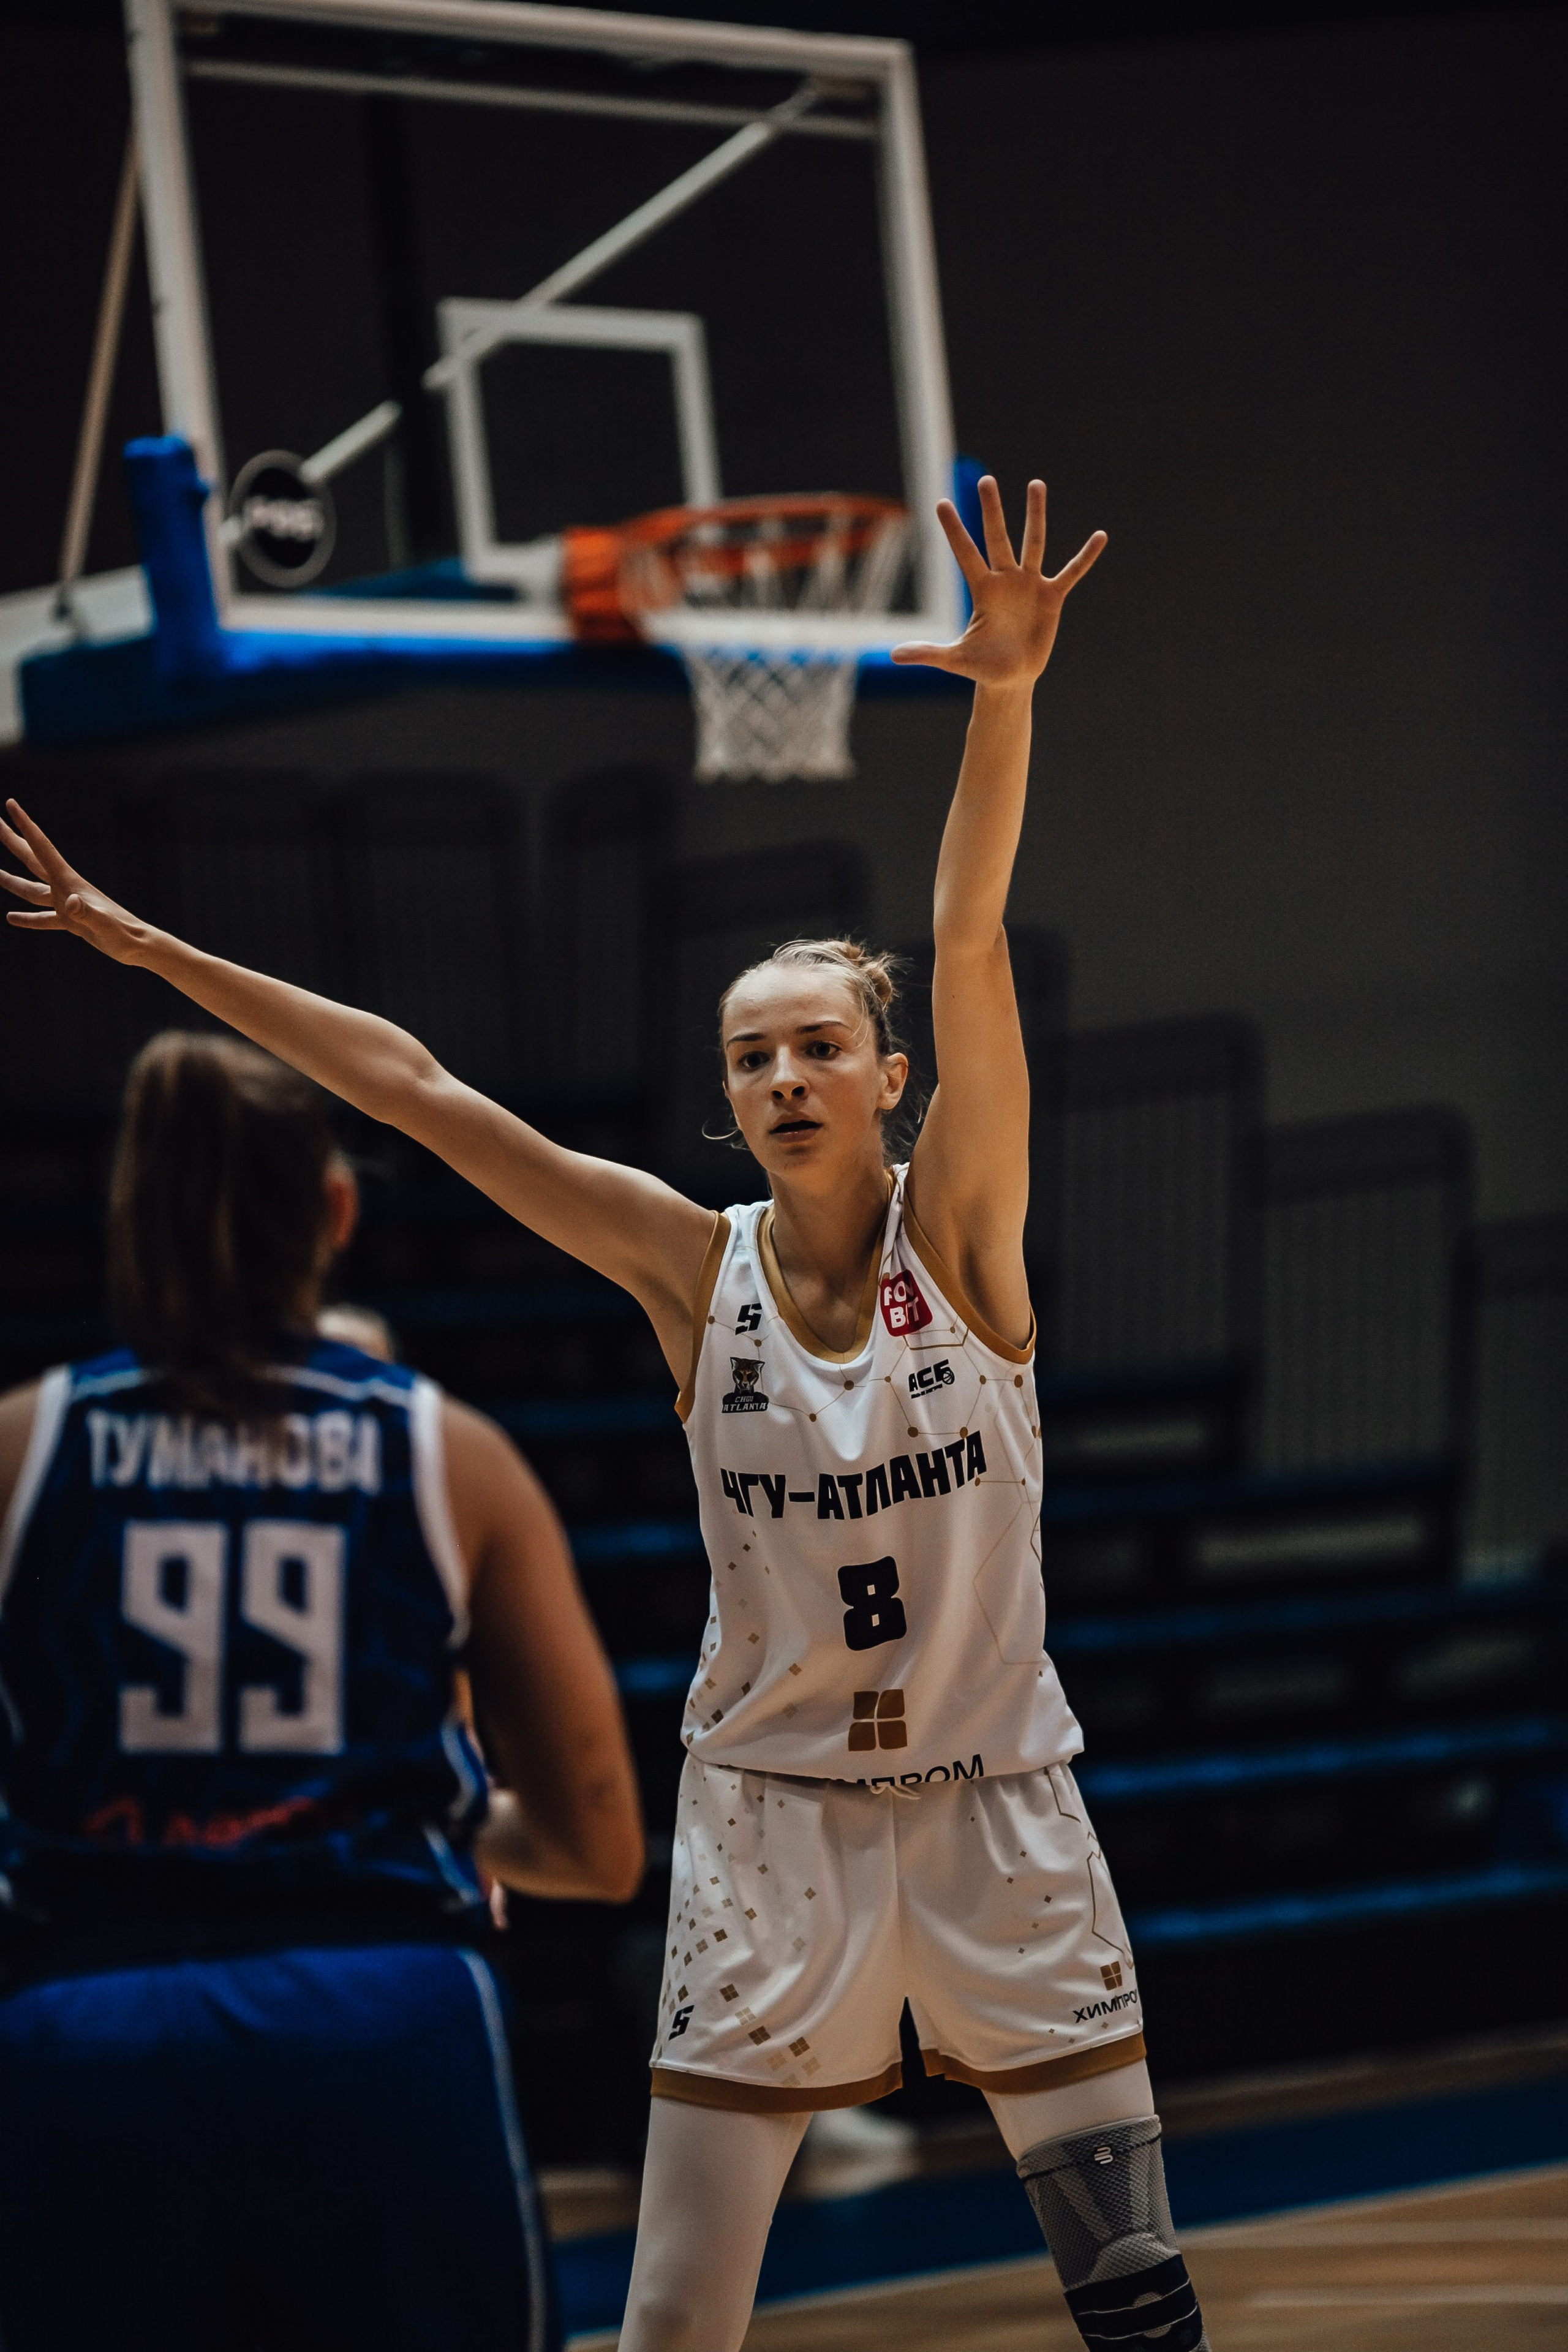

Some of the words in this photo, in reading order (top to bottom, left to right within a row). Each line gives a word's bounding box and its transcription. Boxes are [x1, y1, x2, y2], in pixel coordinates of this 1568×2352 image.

[723, 1403, 767, 1411] ATLANTA
[720, 1430, 987, 1520] ЧГУ-АТЛАНТА
[120, 1518, 346, 1755] 99
[837, 1556, 907, 1651] 8
[1072, 1989, 1137, 2024] ХИМПРО
